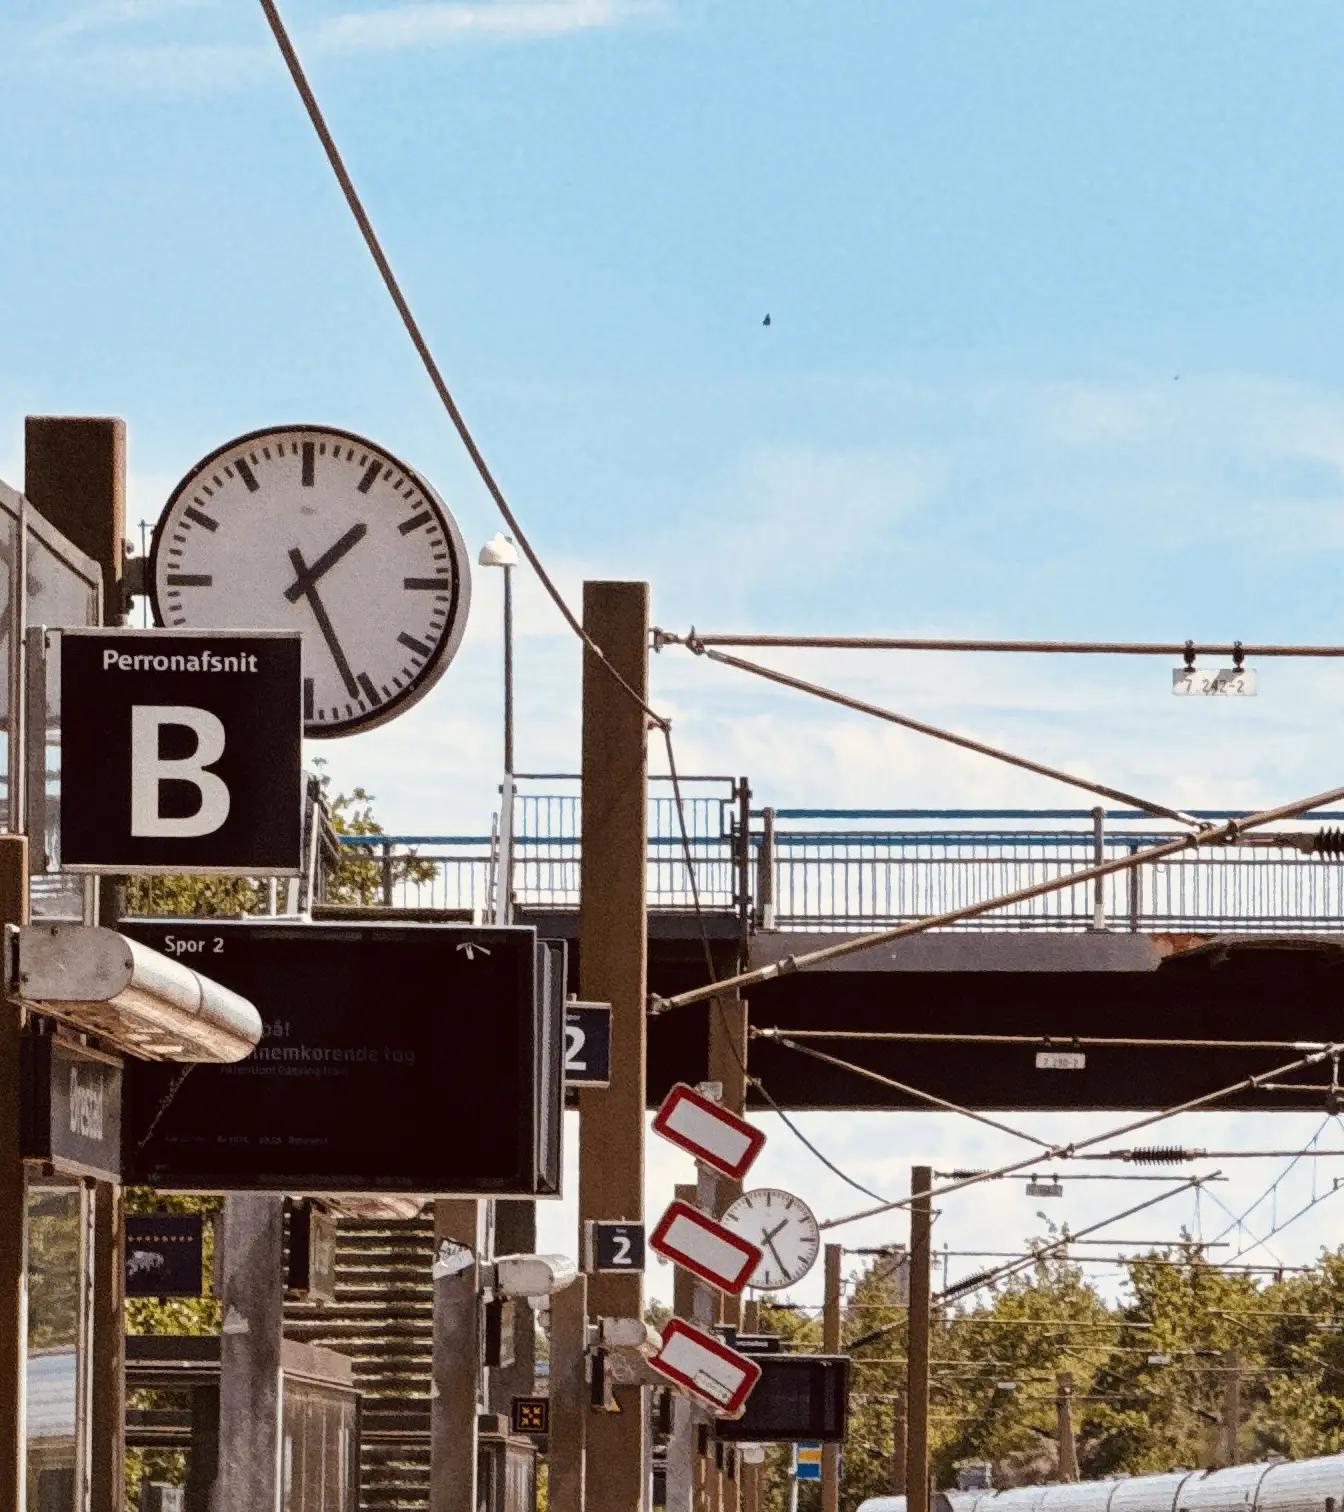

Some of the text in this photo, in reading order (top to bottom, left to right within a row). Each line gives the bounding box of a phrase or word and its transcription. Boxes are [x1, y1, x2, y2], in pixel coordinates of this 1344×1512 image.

[103, 649, 258, 673] Perronafsnit
[130, 705, 231, 838] B
[164, 935, 224, 956] Spor 2
[565, 1026, 587, 1071] 2
[612, 1235, 632, 1265] 2
